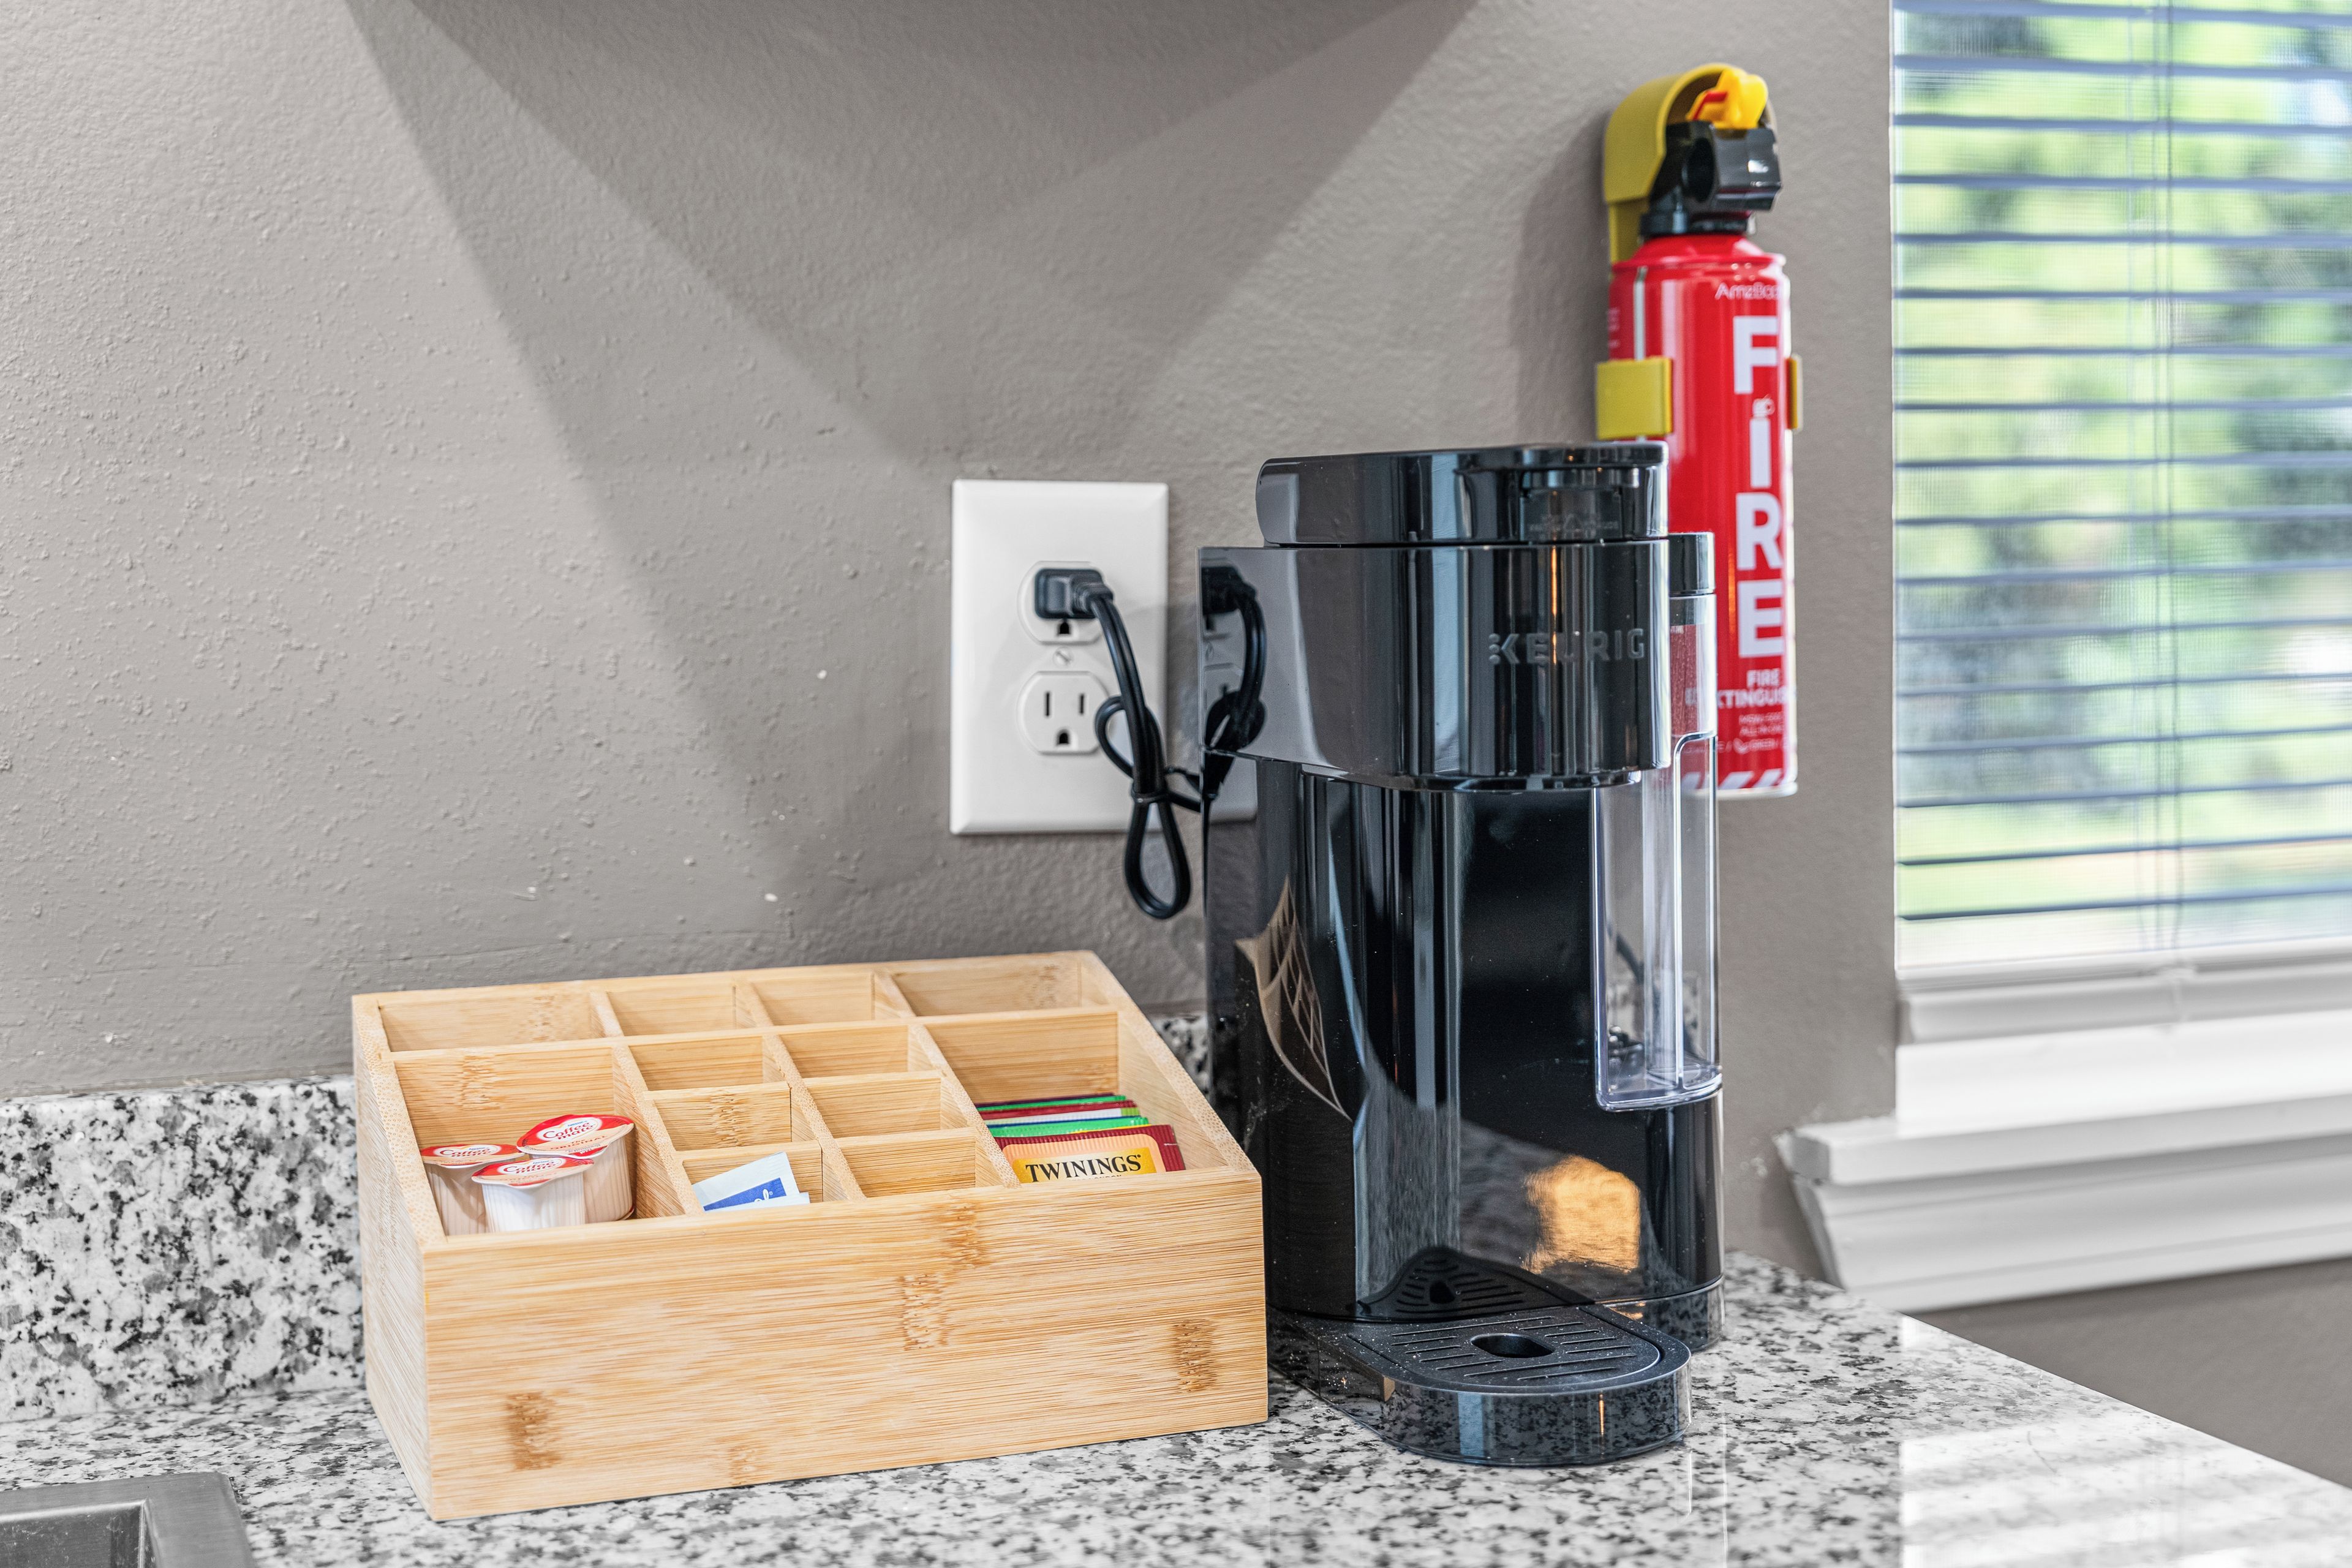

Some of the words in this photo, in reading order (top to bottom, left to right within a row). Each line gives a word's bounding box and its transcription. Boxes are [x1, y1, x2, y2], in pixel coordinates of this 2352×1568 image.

[1747, 668, 1781, 688] FIRE
[543, 1122, 589, 1139] Coffee
[558, 1125, 594, 1140] mate
[503, 1161, 554, 1172] Coffee
[516, 1164, 556, 1174] mate
[1025, 1155, 1141, 1182] TWININGS
